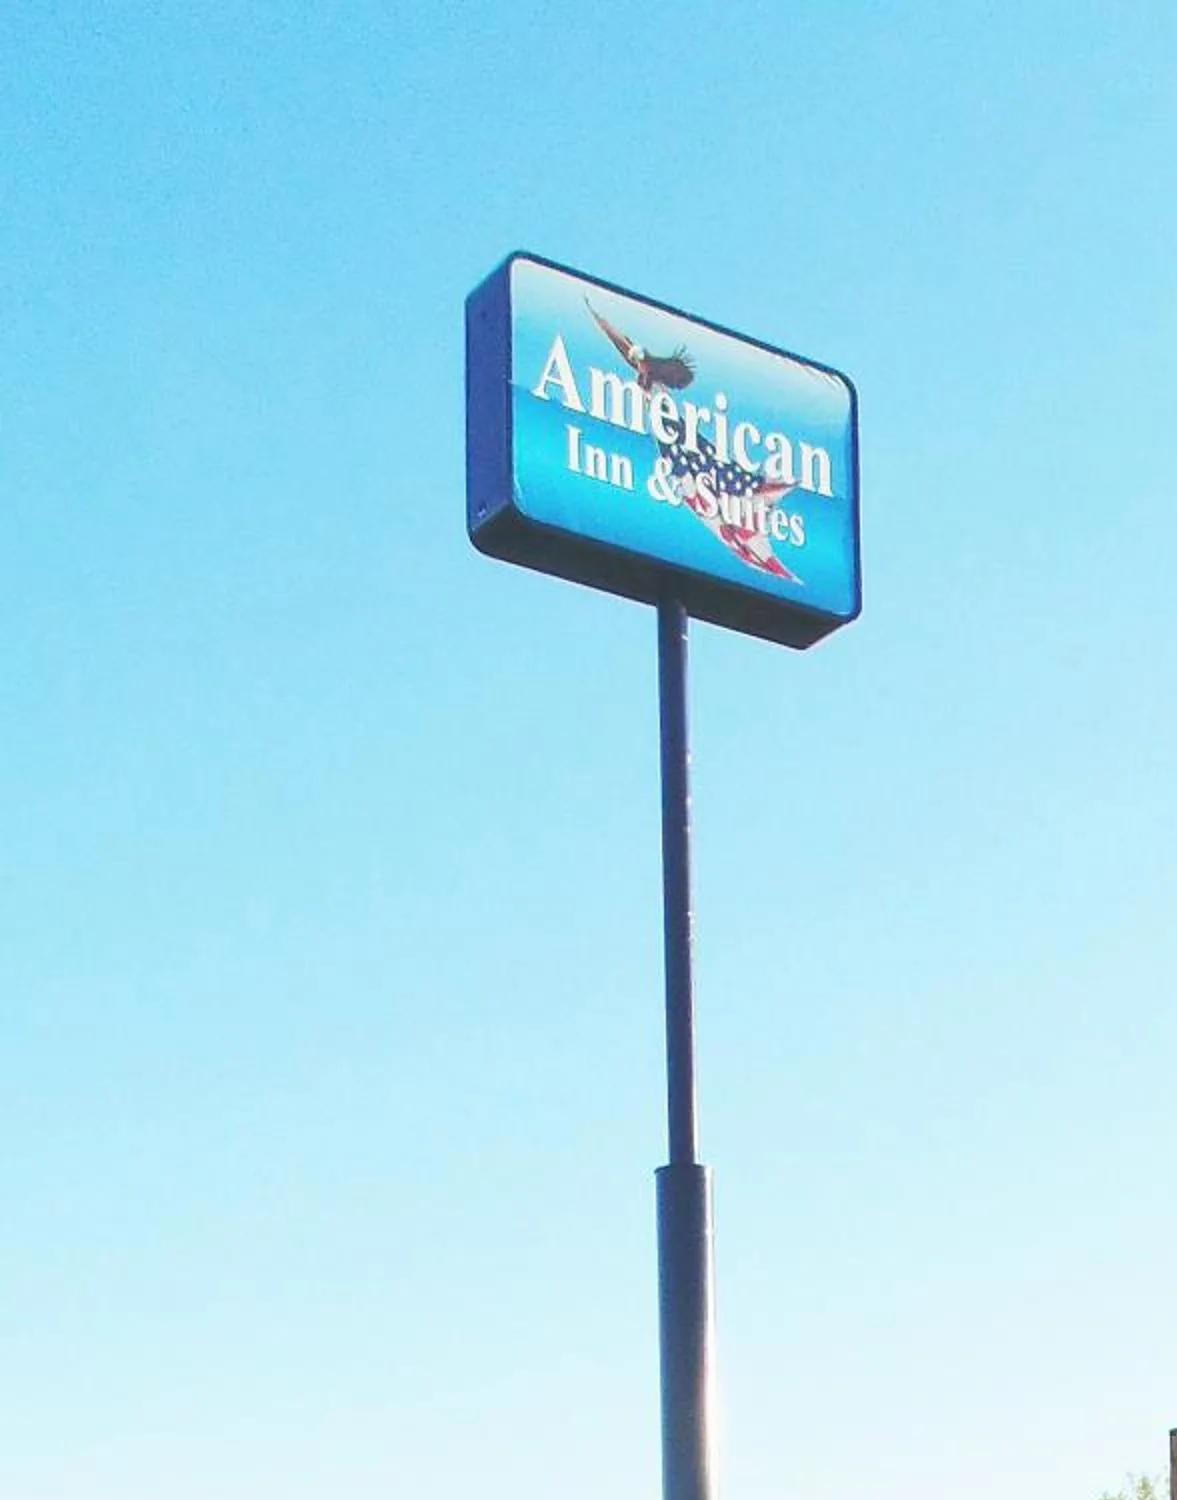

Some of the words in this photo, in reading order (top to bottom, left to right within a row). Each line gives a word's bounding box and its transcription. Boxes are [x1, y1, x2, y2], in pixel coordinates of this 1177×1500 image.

[531, 335, 834, 498] American
[565, 424, 635, 491] Inn
[647, 455, 686, 506] &
[695, 467, 805, 547] Suites
